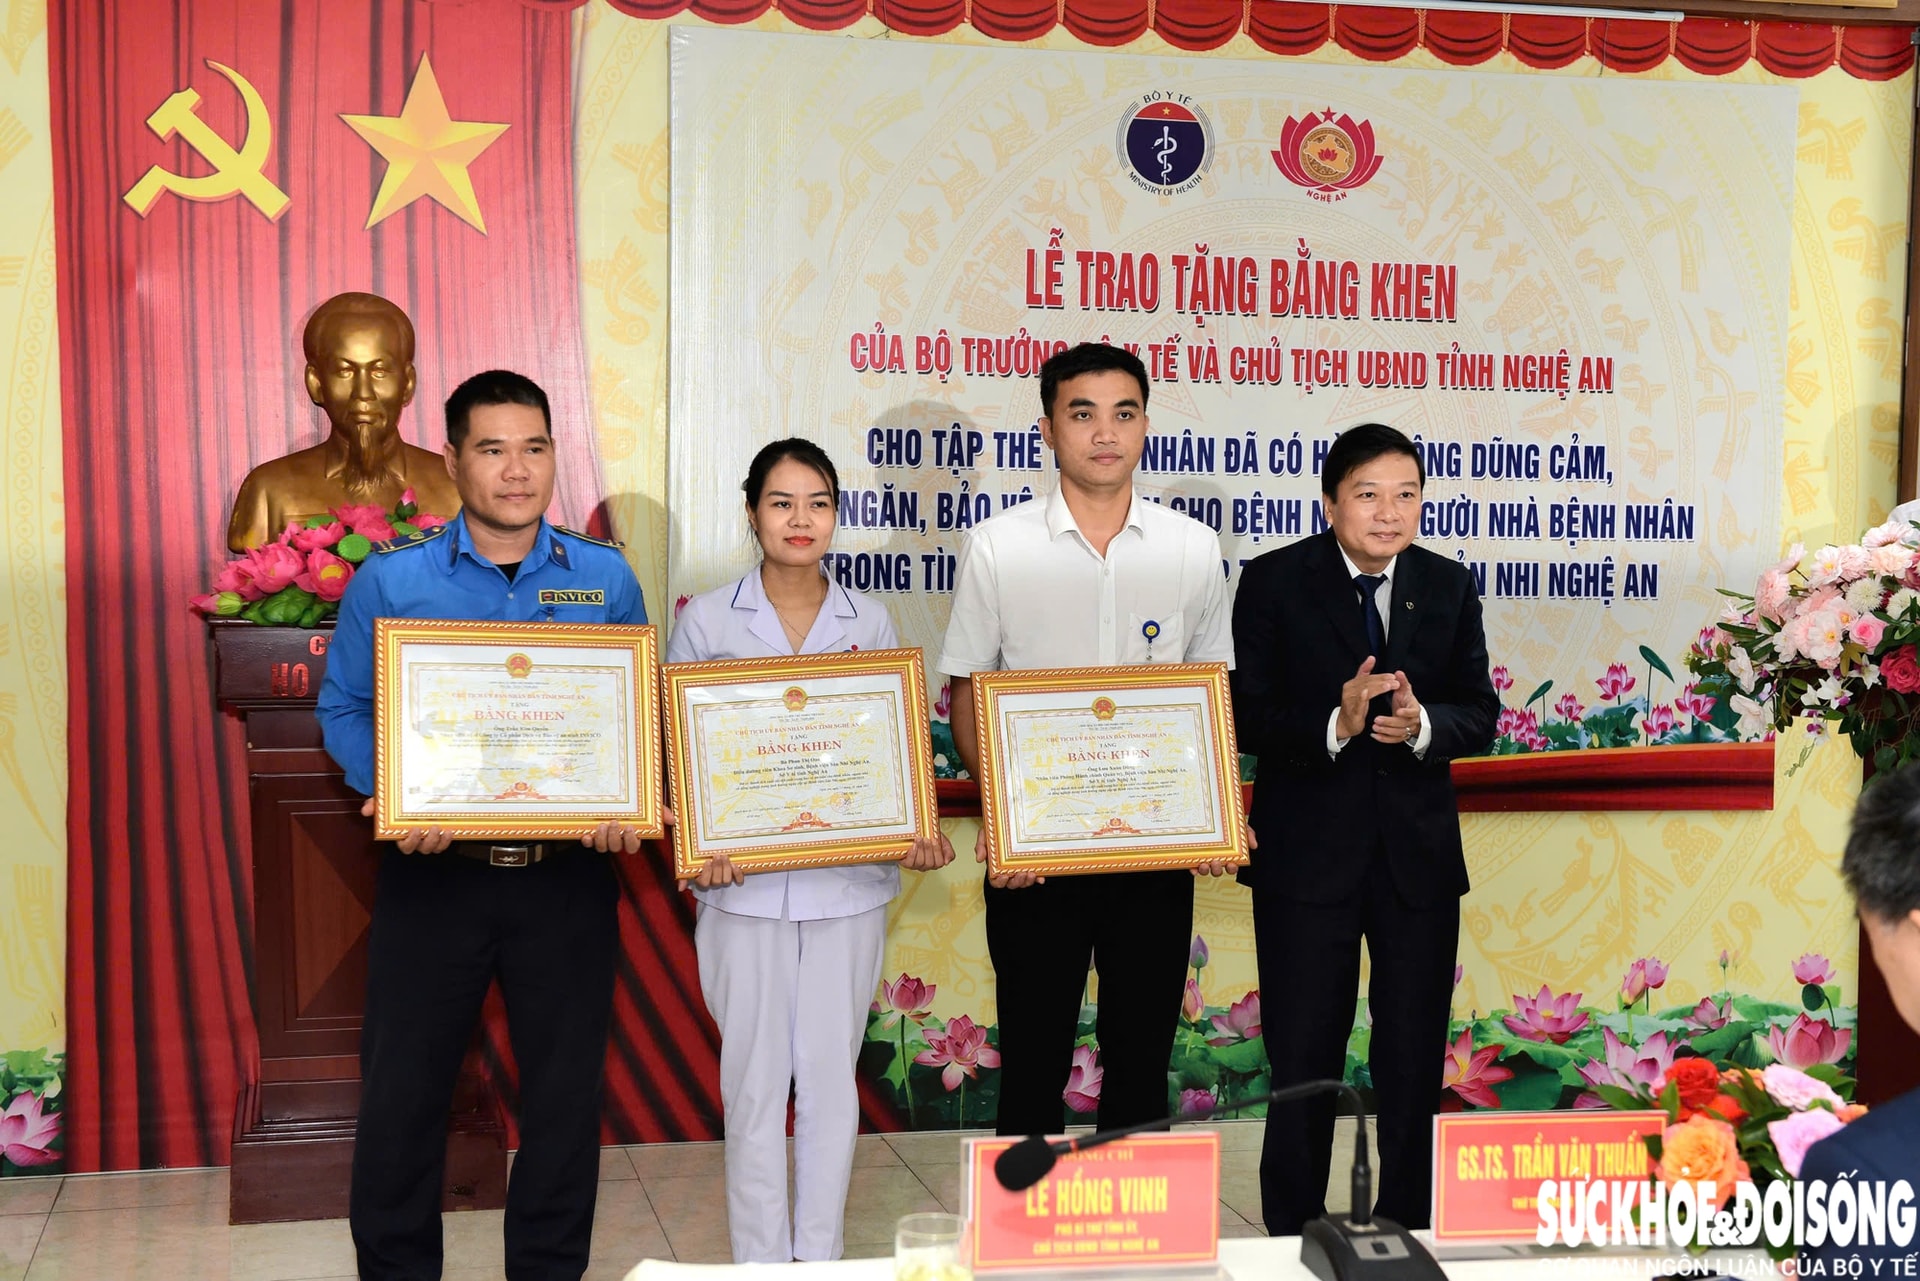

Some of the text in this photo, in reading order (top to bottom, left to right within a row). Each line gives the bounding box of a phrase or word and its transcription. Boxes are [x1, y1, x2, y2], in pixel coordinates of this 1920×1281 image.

[1143, 90, 1193, 105] BỘ Y TẾ
[1128, 171, 1203, 196] MINISTRY OF HEALTH
[1306, 189, 1347, 204] NGHỆ AN
[1026, 227, 1456, 325] LỄ TRAO TẶNG BẰNG KHEN
[850, 321, 905, 370] CỦA
[915, 329, 951, 380] BỘ
[1148, 334, 1179, 379] TẾ
[1187, 339, 1220, 380] VÀ
[1230, 336, 1281, 383] CHỦ
[1290, 348, 1348, 391] TỊCH
[1357, 350, 1427, 386] UBND
[1436, 341, 1494, 388] TỈNH
[1502, 348, 1569, 397] NGHỆ
[1578, 356, 1613, 390] AN
[867, 427, 922, 467] CHO
[933, 422, 983, 476] TẬP
[1141, 428, 1215, 473] NHÂN
[1224, 431, 1259, 474] ĐÃ
[1269, 431, 1302, 475] CÓ
[1471, 436, 1540, 479] DŨNG
[1549, 433, 1613, 485] CẢM,
[840, 483, 925, 532] NGĂN,
[937, 480, 991, 529] BẢO
[1232, 491, 1301, 542] BỆNH
[1420, 493, 1479, 537] GƯỜI
[1488, 495, 1540, 538] NHÀ
[1549, 496, 1616, 546] BỆNH
[1625, 498, 1694, 540] NHÂN
[554, 592, 602, 602] INVICO
[1495, 562, 1539, 597] NHI
[1548, 555, 1615, 606] NGHỆ
[1623, 563, 1658, 598] AN
[474, 705, 565, 721] BẰNG KHEN
[757, 740, 842, 755] BẰNG KHEN
[1068, 747, 1106, 762] BẰNG
[1457, 1129, 1648, 1181] GS.TS. TRẦN VĂN THUẤN
[1057, 1167, 1113, 1217] HỒNG
[1119, 1176, 1168, 1214] VINH
